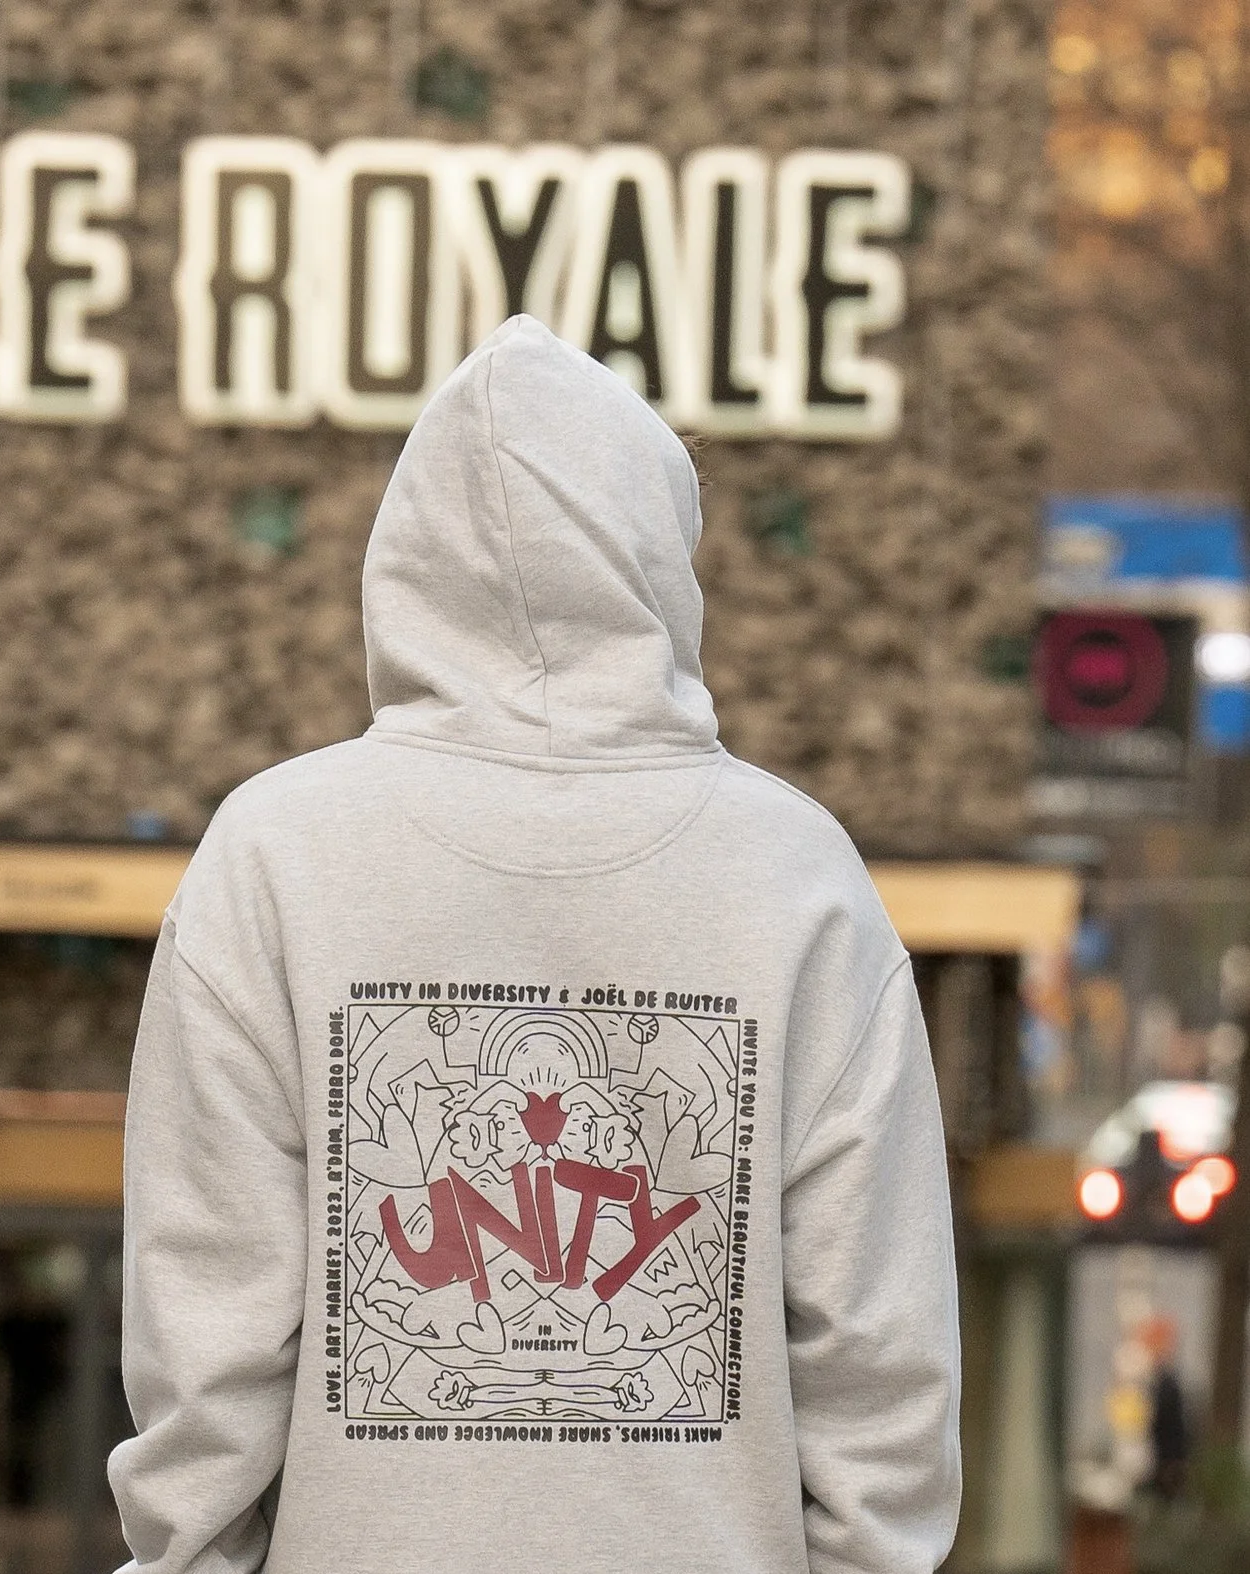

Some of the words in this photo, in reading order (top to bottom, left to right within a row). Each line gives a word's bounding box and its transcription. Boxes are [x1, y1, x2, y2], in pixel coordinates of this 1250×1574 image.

[176, 135, 913, 440] ROYALE
[350, 982, 412, 1000] UNITY
[418, 983, 442, 1000] IN
[447, 983, 551, 1004] DIVERSITY
[581, 983, 627, 1006] JOËL
[634, 990, 658, 1008] DE
[664, 991, 738, 1014] RUITER
[741, 1019, 758, 1077] INVITE
[327, 1064, 344, 1118] FERRO
[739, 1083, 756, 1118] YOU
[738, 1123, 754, 1152] TO:
[734, 1157, 752, 1205] MAKE
[379, 1158, 701, 1302] UNITY
[730, 1210, 749, 1301] BEAUTIFUL
[325, 1323, 342, 1358] ART
[511, 1338, 578, 1352] DIVERSITY
[537, 1324, 552, 1335] IN
[345, 1424, 409, 1441] SPREAD
[414, 1424, 448, 1441] AND
[454, 1424, 552, 1442] KNOWLEDGE
[558, 1425, 611, 1443] SHARE
[684, 1427, 723, 1443] MAKE
